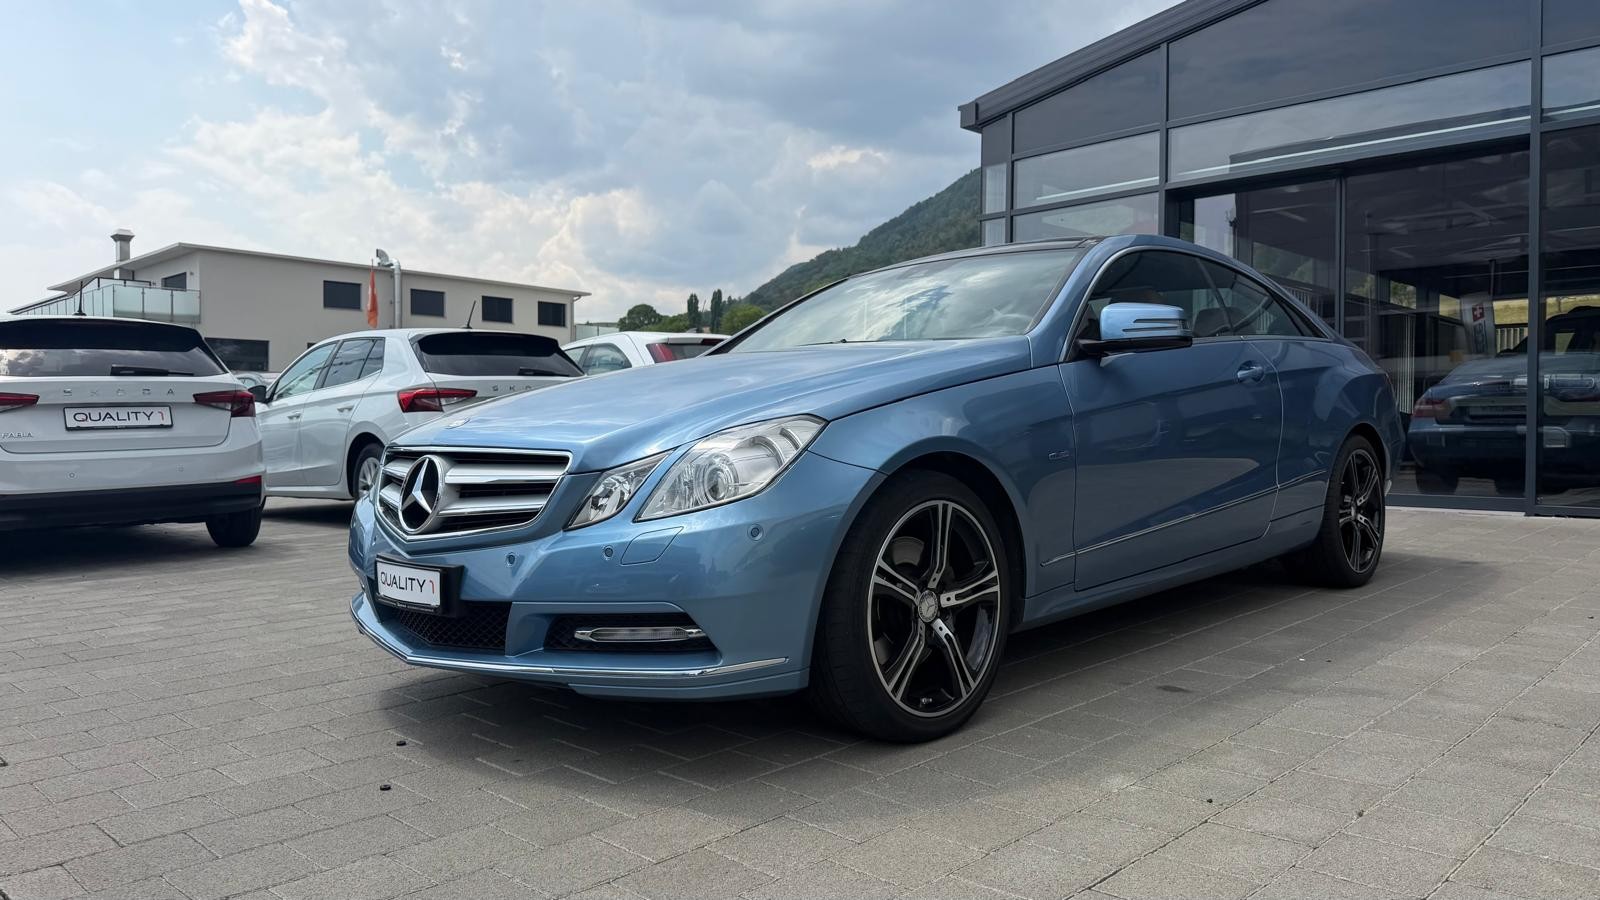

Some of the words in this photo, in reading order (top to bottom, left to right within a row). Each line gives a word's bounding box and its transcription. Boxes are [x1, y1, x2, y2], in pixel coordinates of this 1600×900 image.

[73, 410, 154, 422] QUALITY
[157, 410, 165, 421] 1
[380, 571, 426, 593] QUALITY
[429, 579, 435, 595] 1
